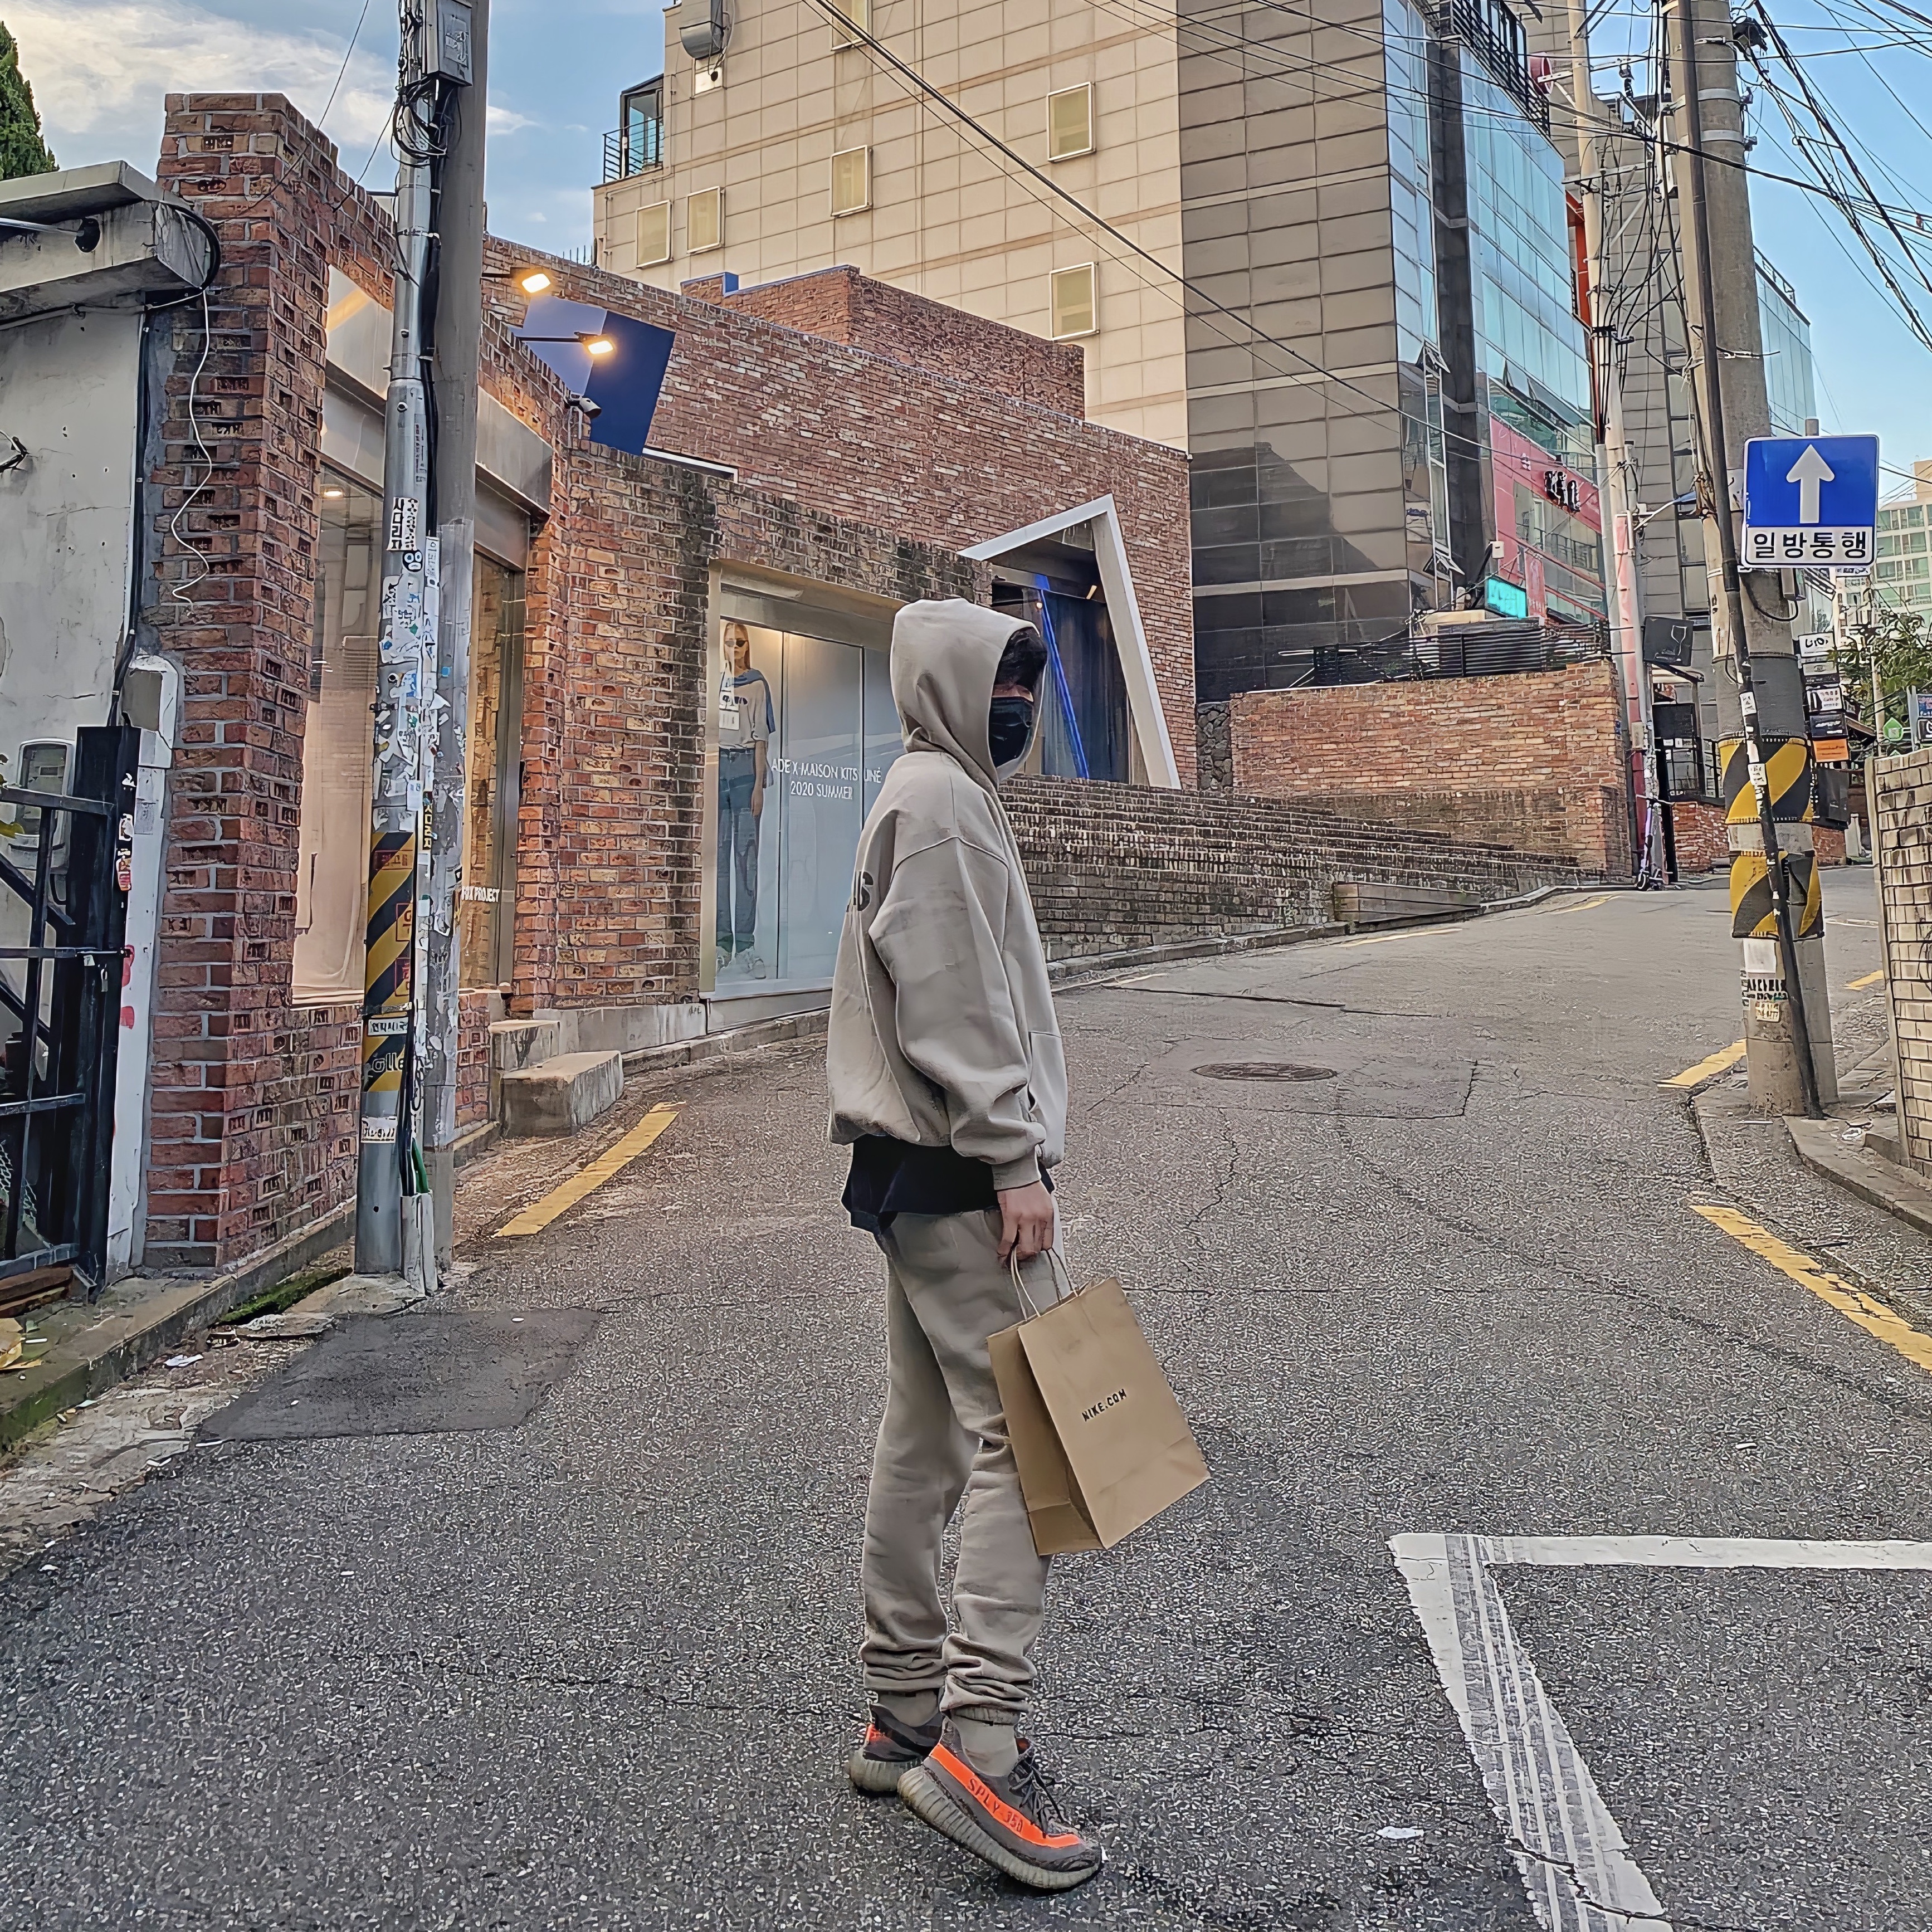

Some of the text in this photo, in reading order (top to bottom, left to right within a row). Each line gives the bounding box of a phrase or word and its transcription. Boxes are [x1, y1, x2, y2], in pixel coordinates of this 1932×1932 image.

[1754, 531, 1866, 559] 일방통행
[801, 762, 838, 780] MAISON
[790, 780, 853, 800] 2020 SUMMER
[474, 886, 500, 902] PROJECT
[1081, 1388, 1127, 1422] NIKE.COM
[968, 1779, 1023, 1833] SPLY-350
